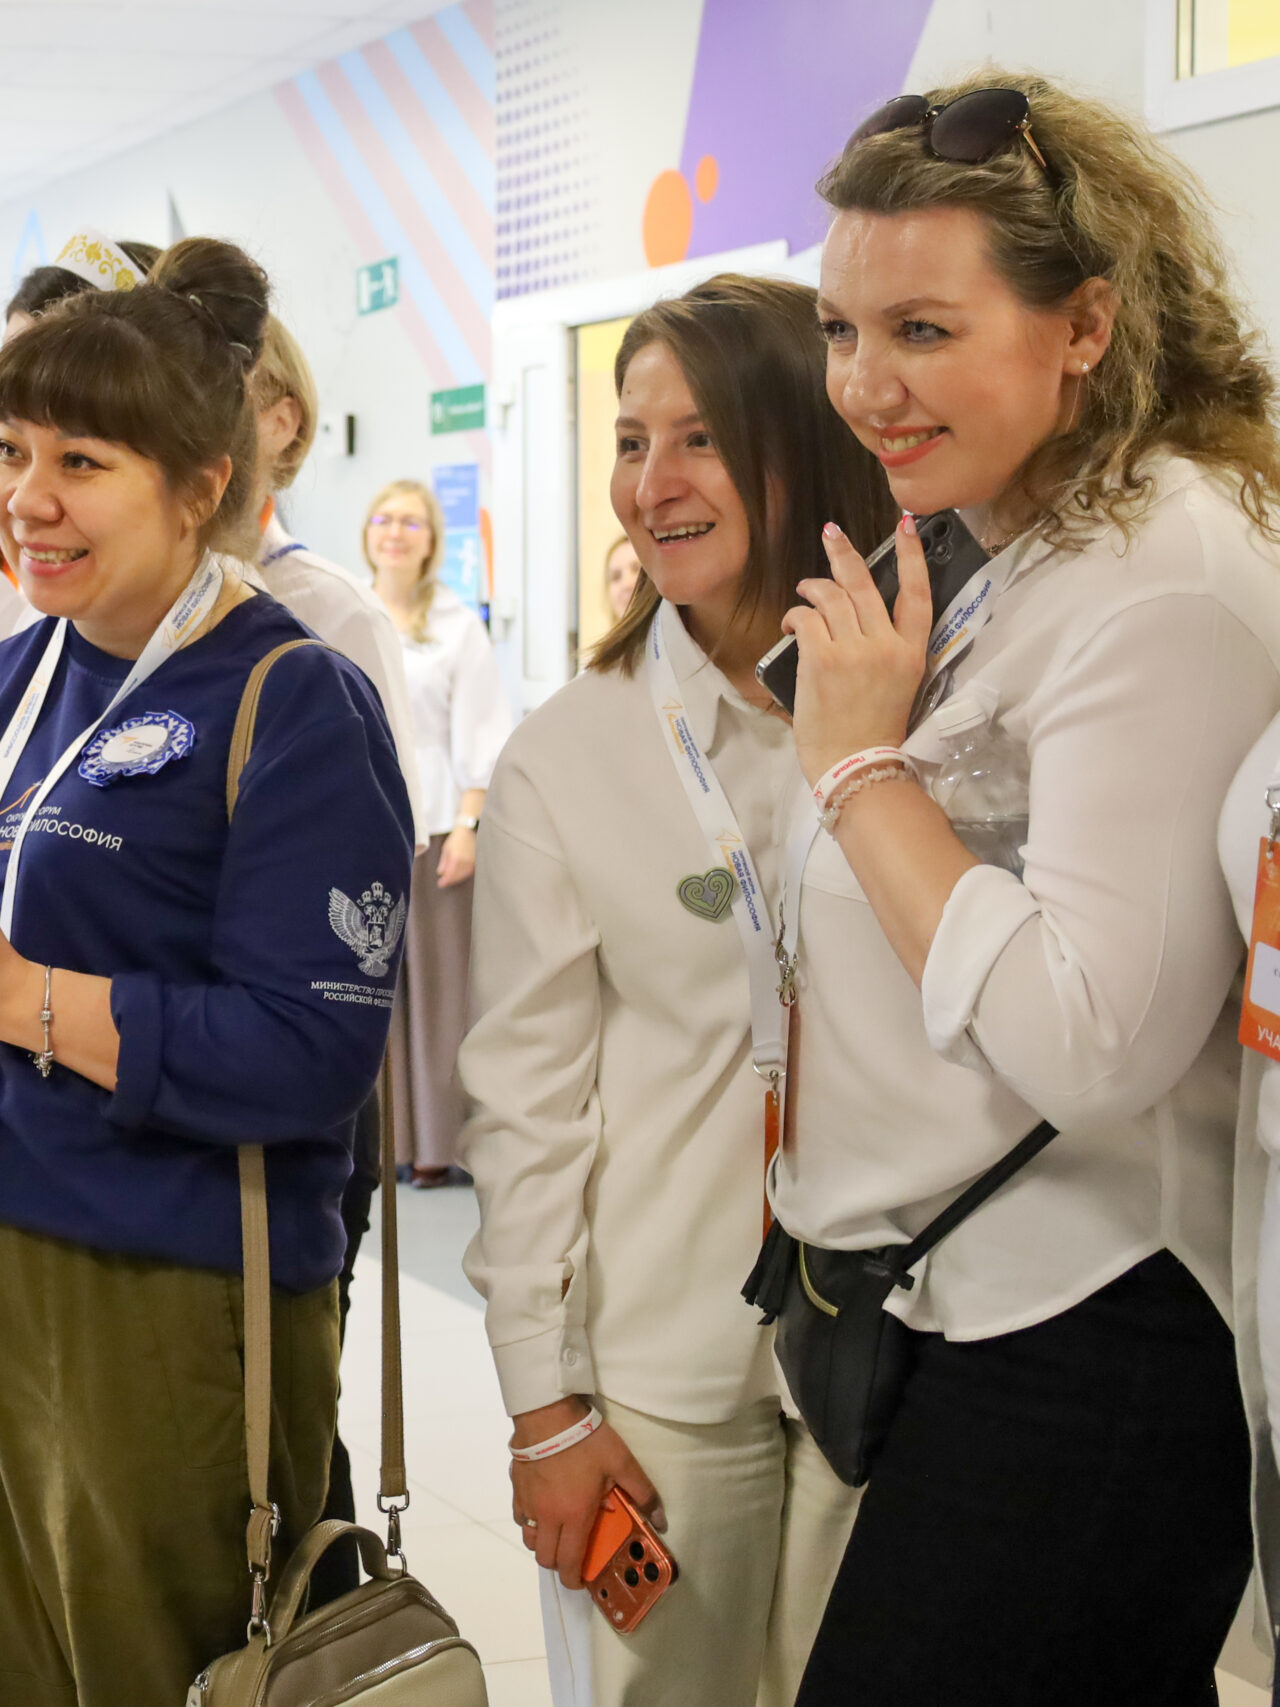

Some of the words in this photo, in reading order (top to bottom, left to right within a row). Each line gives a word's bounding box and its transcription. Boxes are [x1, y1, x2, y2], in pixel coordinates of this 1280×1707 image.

[933, 628, 955, 655] НОВАЯ
[954, 579, 992, 629] ФИЛОСОФИЯ
[684, 744, 711, 794] ФИЛОСОФИЯ
[27, 818, 123, 851] ИЛОСОФИЯ
[730, 851, 745, 879] НОВАЯ
[740, 878, 762, 932] ФИЛОСОФИЯ
[310, 981, 375, 995] МИНИСТЕРСТВО
[323, 991, 373, 1005] РОССИЙСКОЙ
